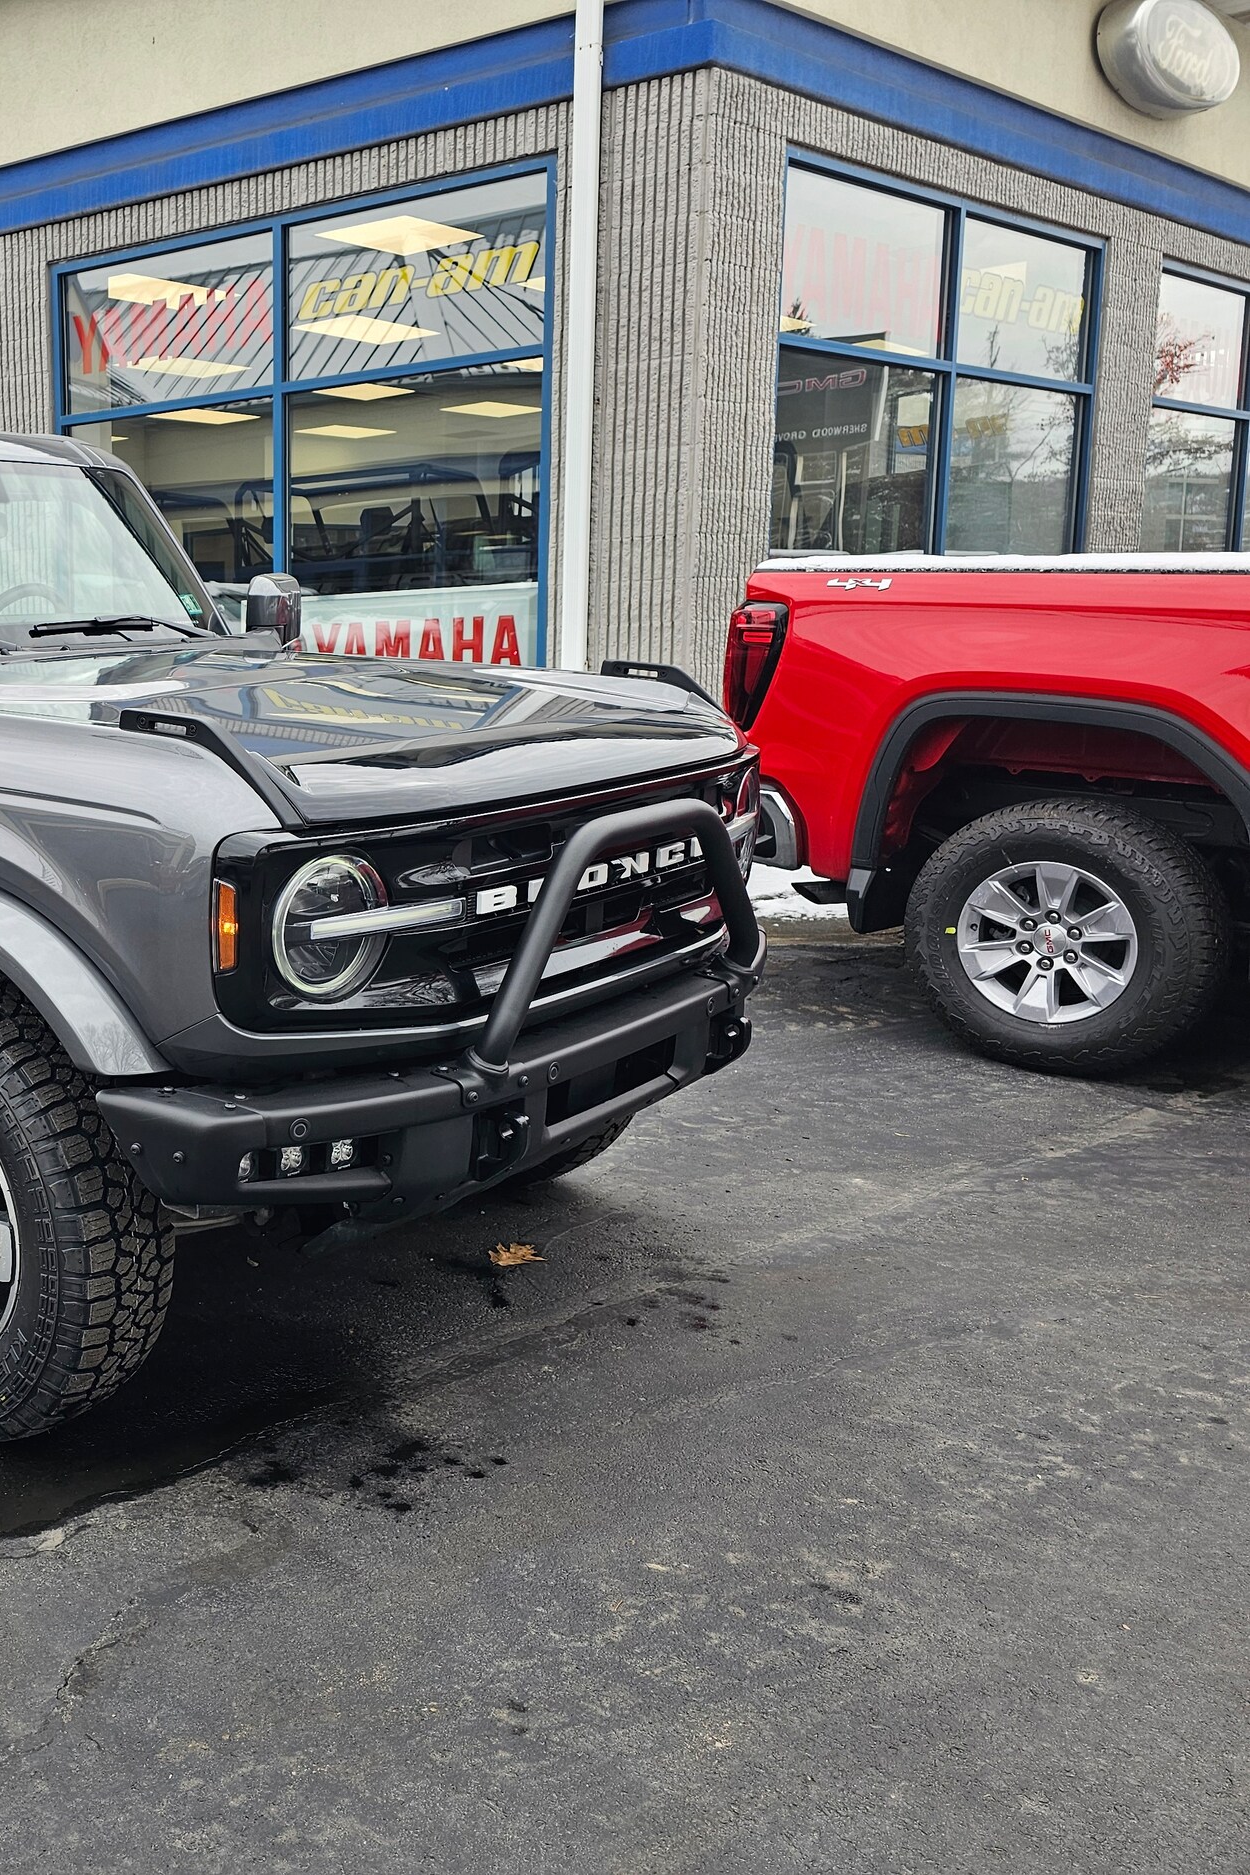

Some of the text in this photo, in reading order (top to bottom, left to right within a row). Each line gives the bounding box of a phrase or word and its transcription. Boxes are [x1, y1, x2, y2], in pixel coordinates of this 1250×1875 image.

[1159, 14, 1213, 88] Ford
[297, 240, 540, 320] can-am
[72, 277, 274, 374] YAMAHA
[312, 615, 522, 666] YAMAHA
[1044, 929, 1054, 953] GMC
